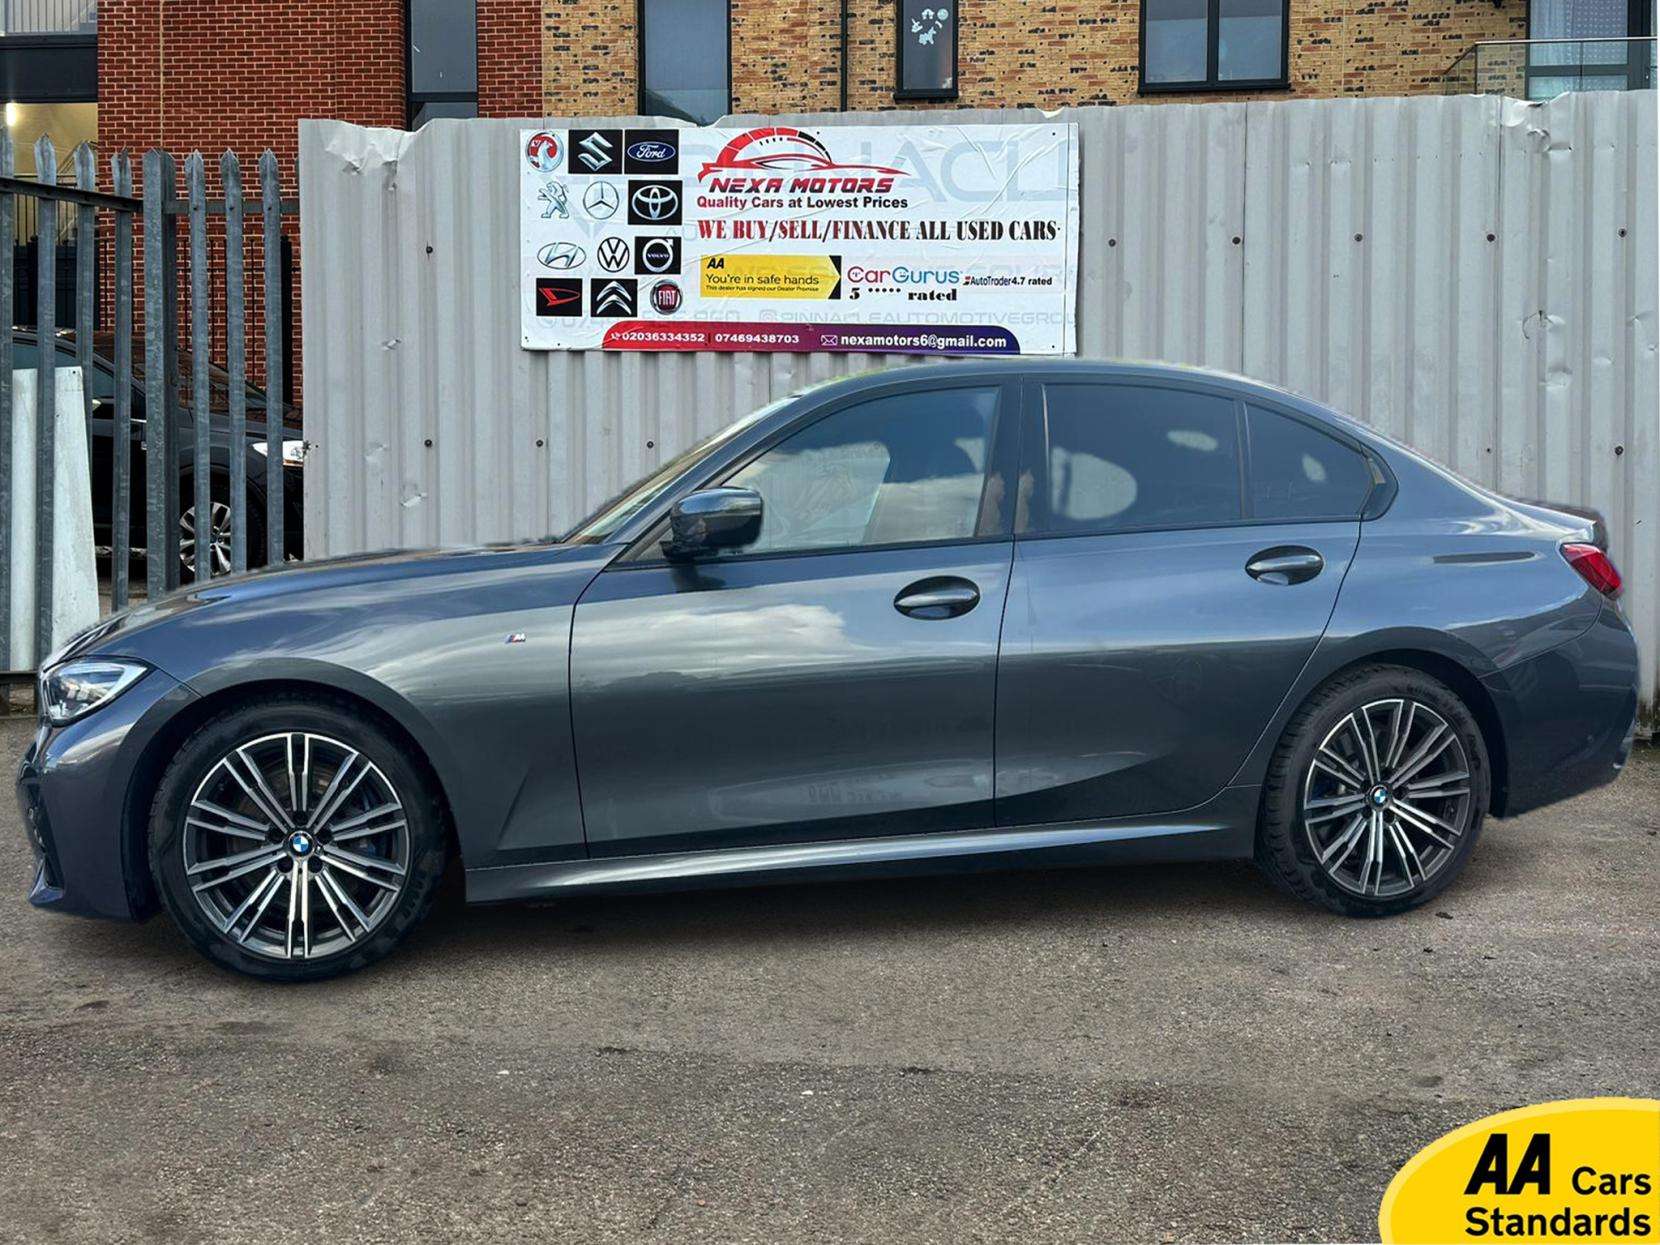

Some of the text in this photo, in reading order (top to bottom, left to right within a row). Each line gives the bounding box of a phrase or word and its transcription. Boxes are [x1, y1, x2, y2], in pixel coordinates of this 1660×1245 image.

[636, 144, 666, 158] Ford
[709, 178, 894, 193] NEXA MOTORS
[697, 196, 908, 210] Quality Cars at Lowest Prices
[697, 220, 726, 239] WE
[733, 220, 910, 242] BUY/SELL/FINANCE
[916, 220, 950, 240] ALL
[956, 220, 1003, 240] USED
[1008, 220, 1057, 240] CARS
[707, 258, 724, 269] AA
[706, 274, 820, 285] You're in safe hands
[847, 266, 960, 284] CarGurus
[1028, 277, 1052, 285] rated
[658, 290, 676, 306] FIAT
[849, 288, 957, 301] 5 rated
[622, 333, 799, 343] 02036334352 07469438703
[841, 336, 1006, 348] nexamotors6@gmail.com
